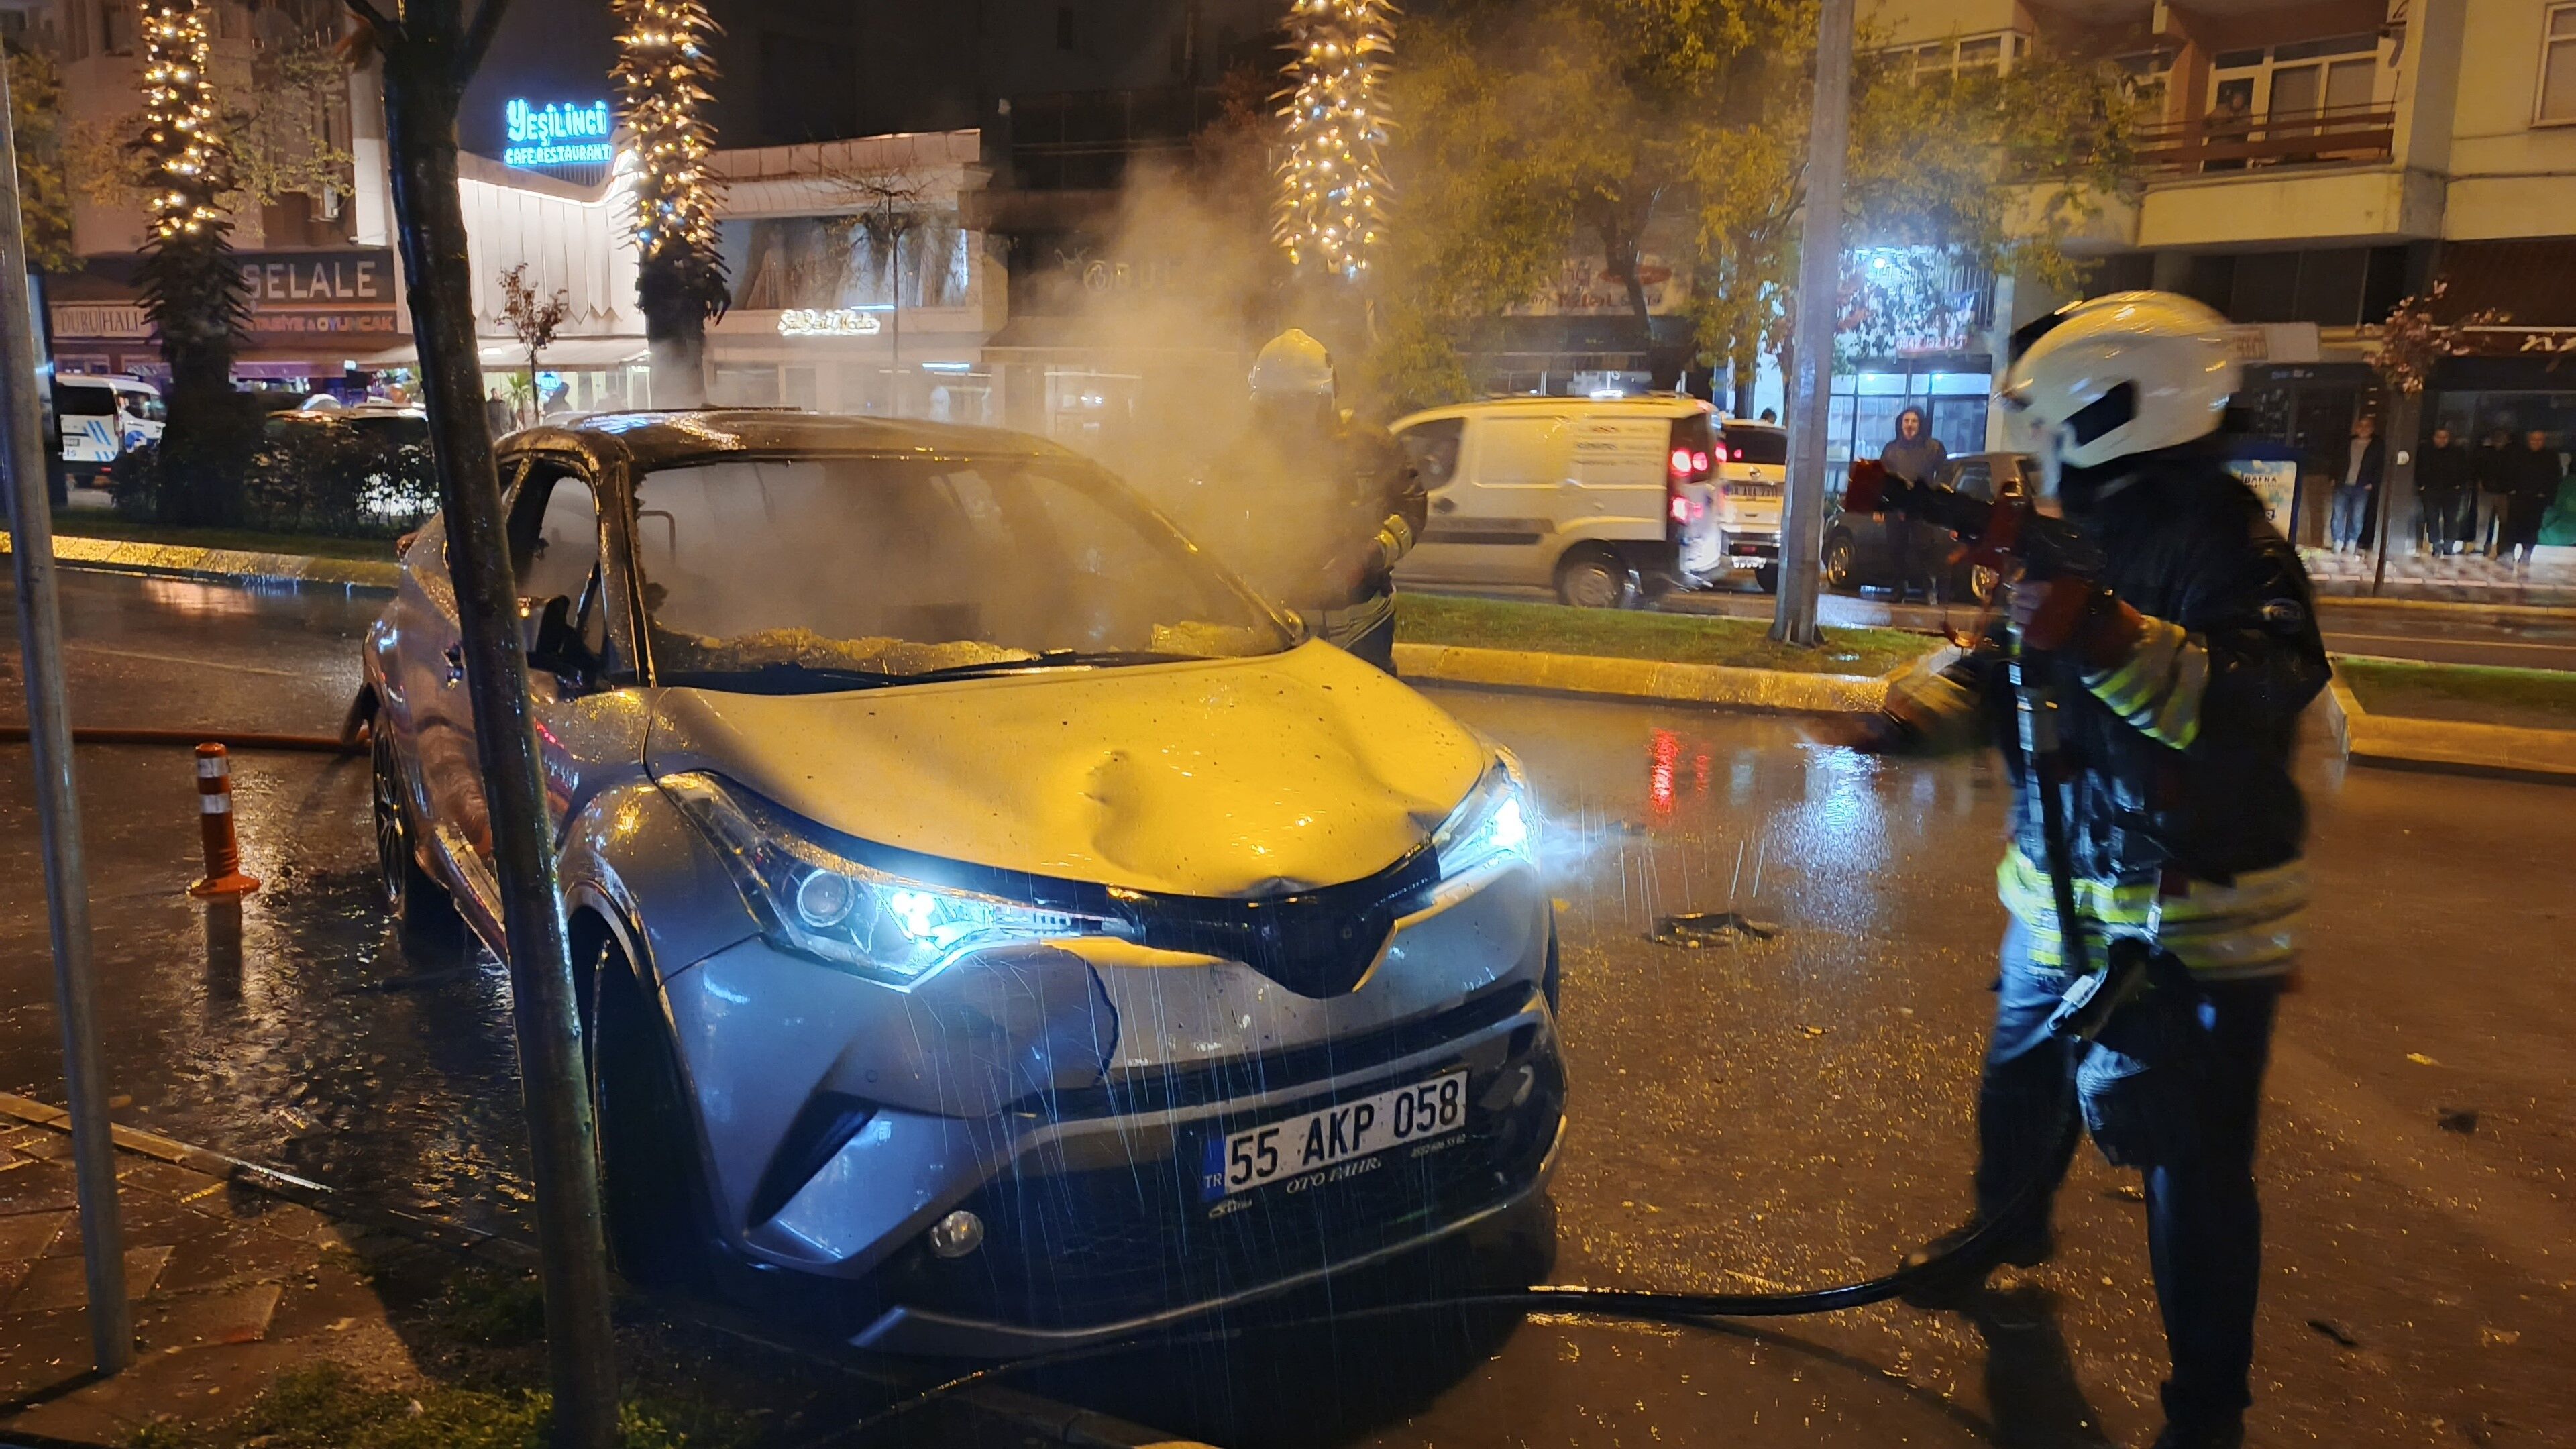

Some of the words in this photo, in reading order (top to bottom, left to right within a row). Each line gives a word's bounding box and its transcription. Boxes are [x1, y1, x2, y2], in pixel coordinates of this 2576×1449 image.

[505, 148, 537, 165] CAFE
[537, 143, 612, 164] RESTAURANT
[61, 311, 99, 333] DURU
[1230, 1128, 1280, 1185] 55
[1302, 1103, 1375, 1166] AKP
[1393, 1079, 1458, 1138] 058
[1204, 1172, 1222, 1189] TR
[1286, 1171, 1326, 1194] OTO
